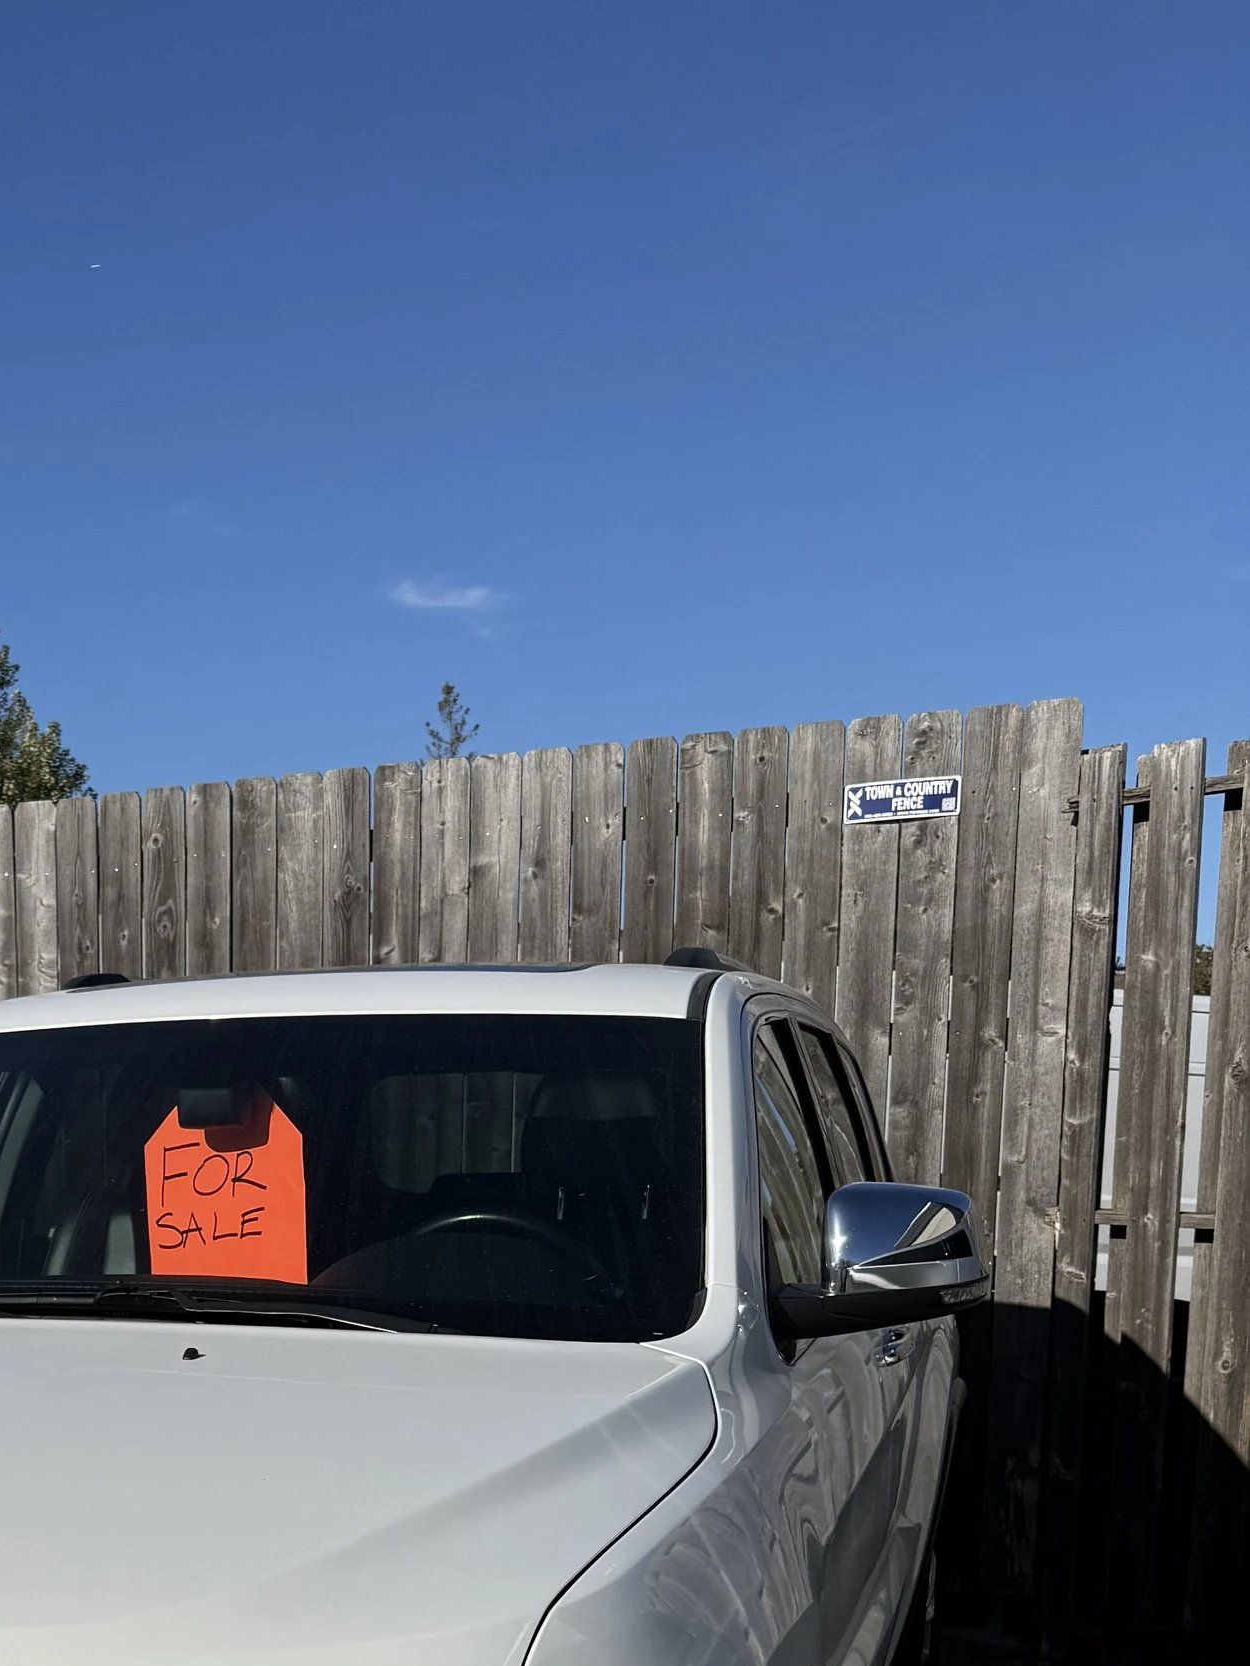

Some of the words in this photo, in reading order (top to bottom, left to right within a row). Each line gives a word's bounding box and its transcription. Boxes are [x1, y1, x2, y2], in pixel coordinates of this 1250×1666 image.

[865, 785, 894, 800] TOWN
[895, 786, 902, 796] &
[904, 781, 954, 796] COUNTRY
[891, 797, 924, 811] FENCE
[162, 1142, 267, 1207] FOR
[156, 1207, 265, 1249] SALE
